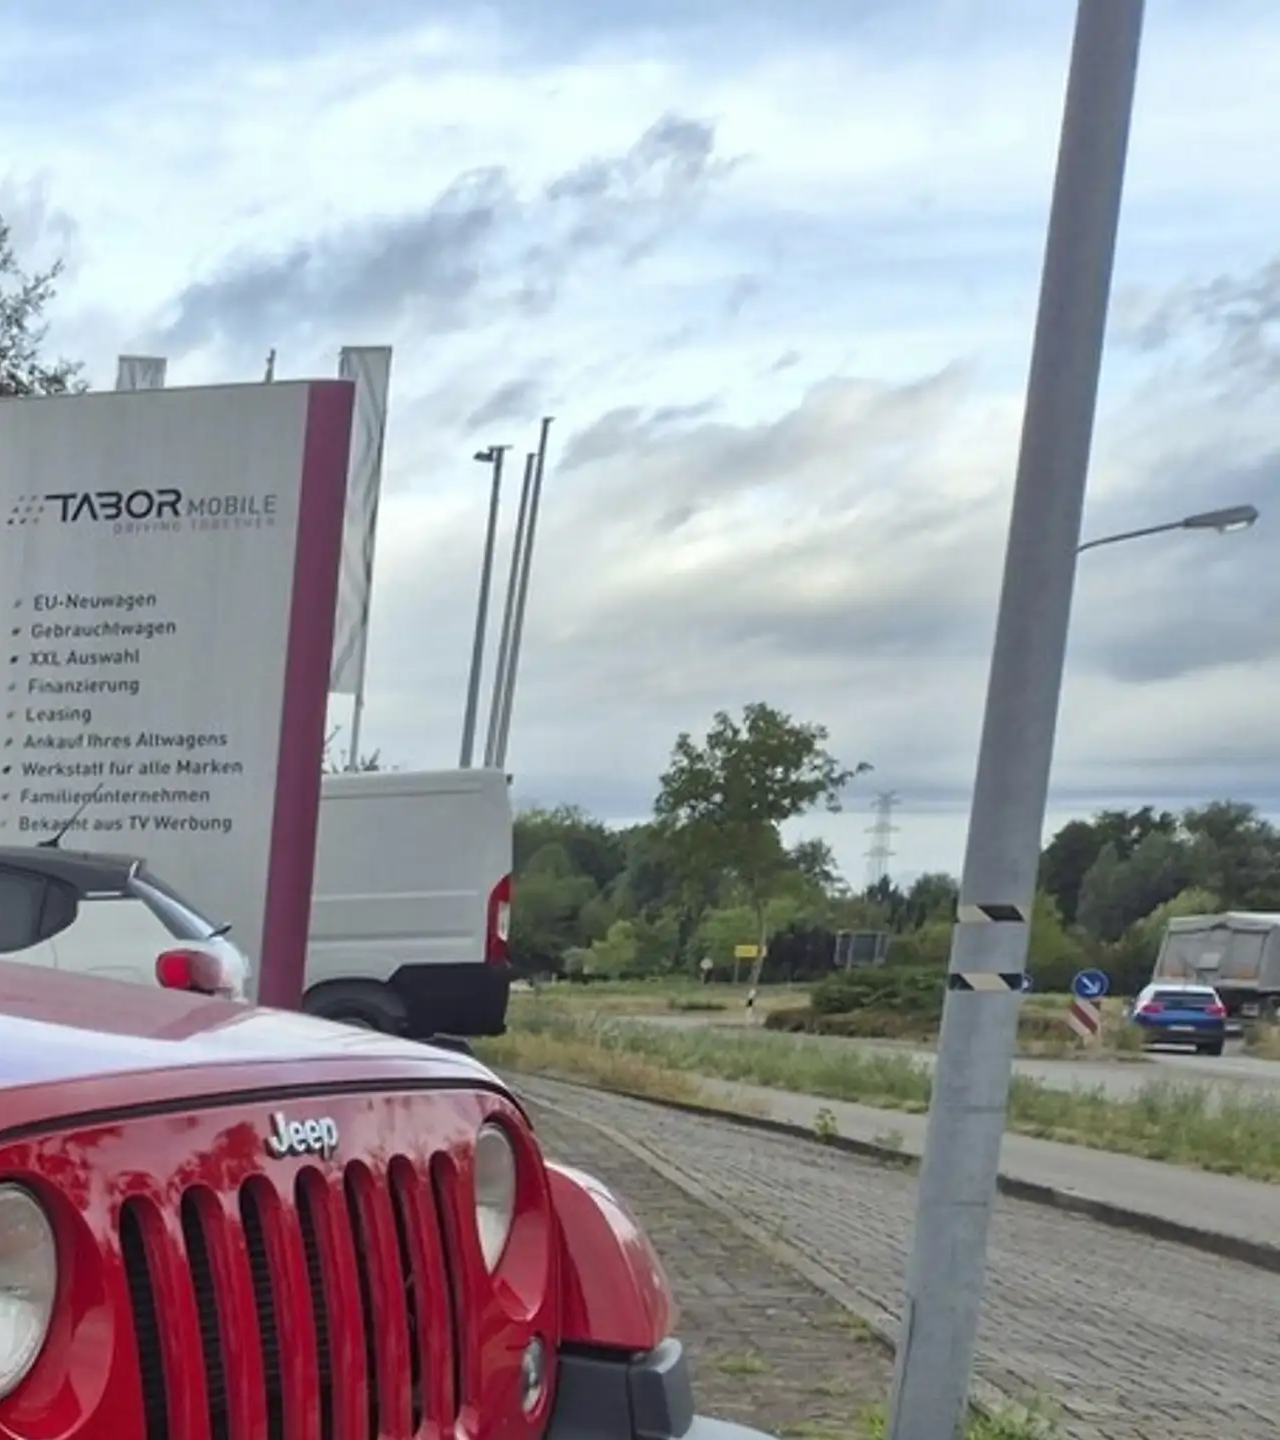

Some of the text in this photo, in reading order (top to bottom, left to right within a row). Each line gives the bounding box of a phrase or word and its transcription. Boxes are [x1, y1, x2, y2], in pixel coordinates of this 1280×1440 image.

[44, 488, 278, 523] TABOR MOBILE
[33, 593, 157, 612] EU-Neuwagen
[30, 620, 177, 640] Gebrauchtwagen
[28, 649, 140, 666] XXL Auswahl
[27, 677, 140, 696] Finanzierung
[25, 708, 92, 725] Leasing
[23, 731, 228, 750] Ankauf Ihres Altwagens
[21, 761, 104, 777] Werkstatt
[138, 760, 171, 775] alle
[176, 758, 243, 776] Marken
[93, 818, 123, 832] aus
[129, 815, 150, 831] TV
[153, 815, 233, 834] Werbung
[267, 1111, 339, 1160] Jeep
